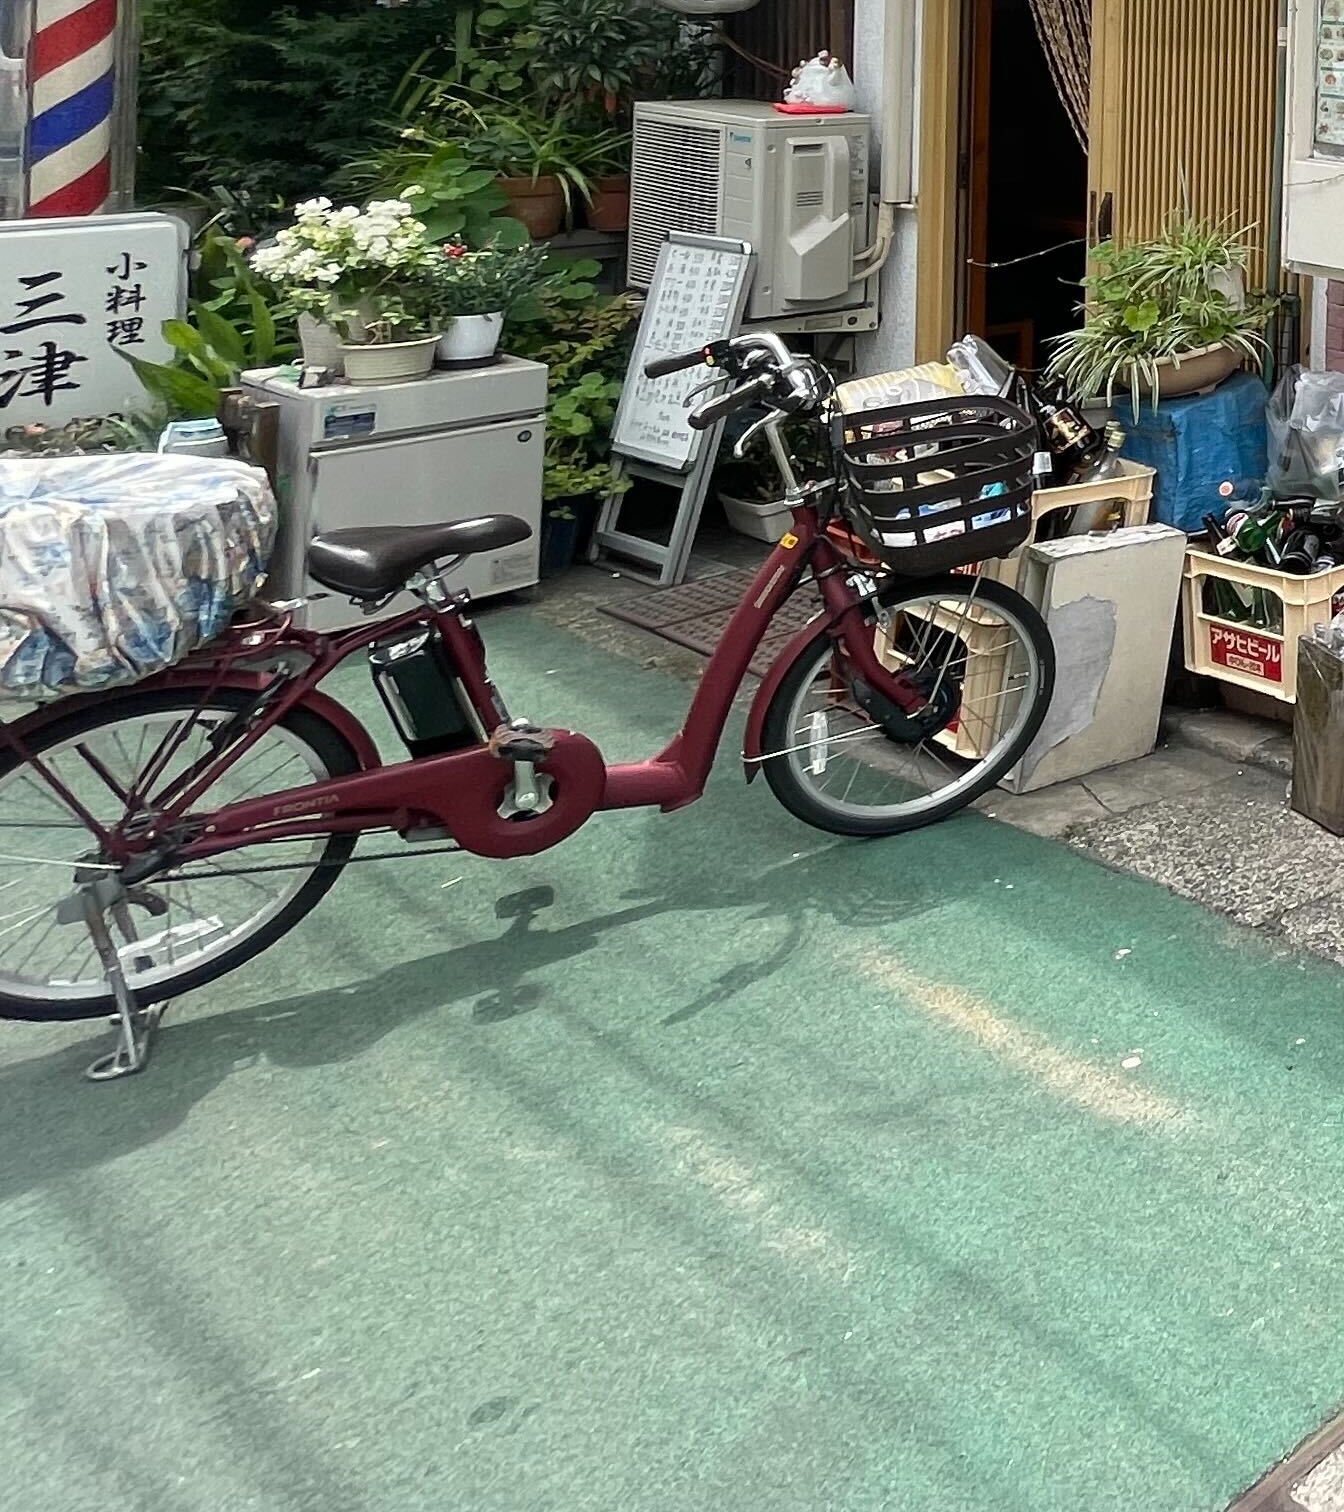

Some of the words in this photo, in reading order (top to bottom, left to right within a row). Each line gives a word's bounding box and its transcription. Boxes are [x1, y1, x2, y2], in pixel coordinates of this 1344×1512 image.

[105, 251, 148, 346] 小料理
[1210, 627, 1280, 663] アサヒビール
